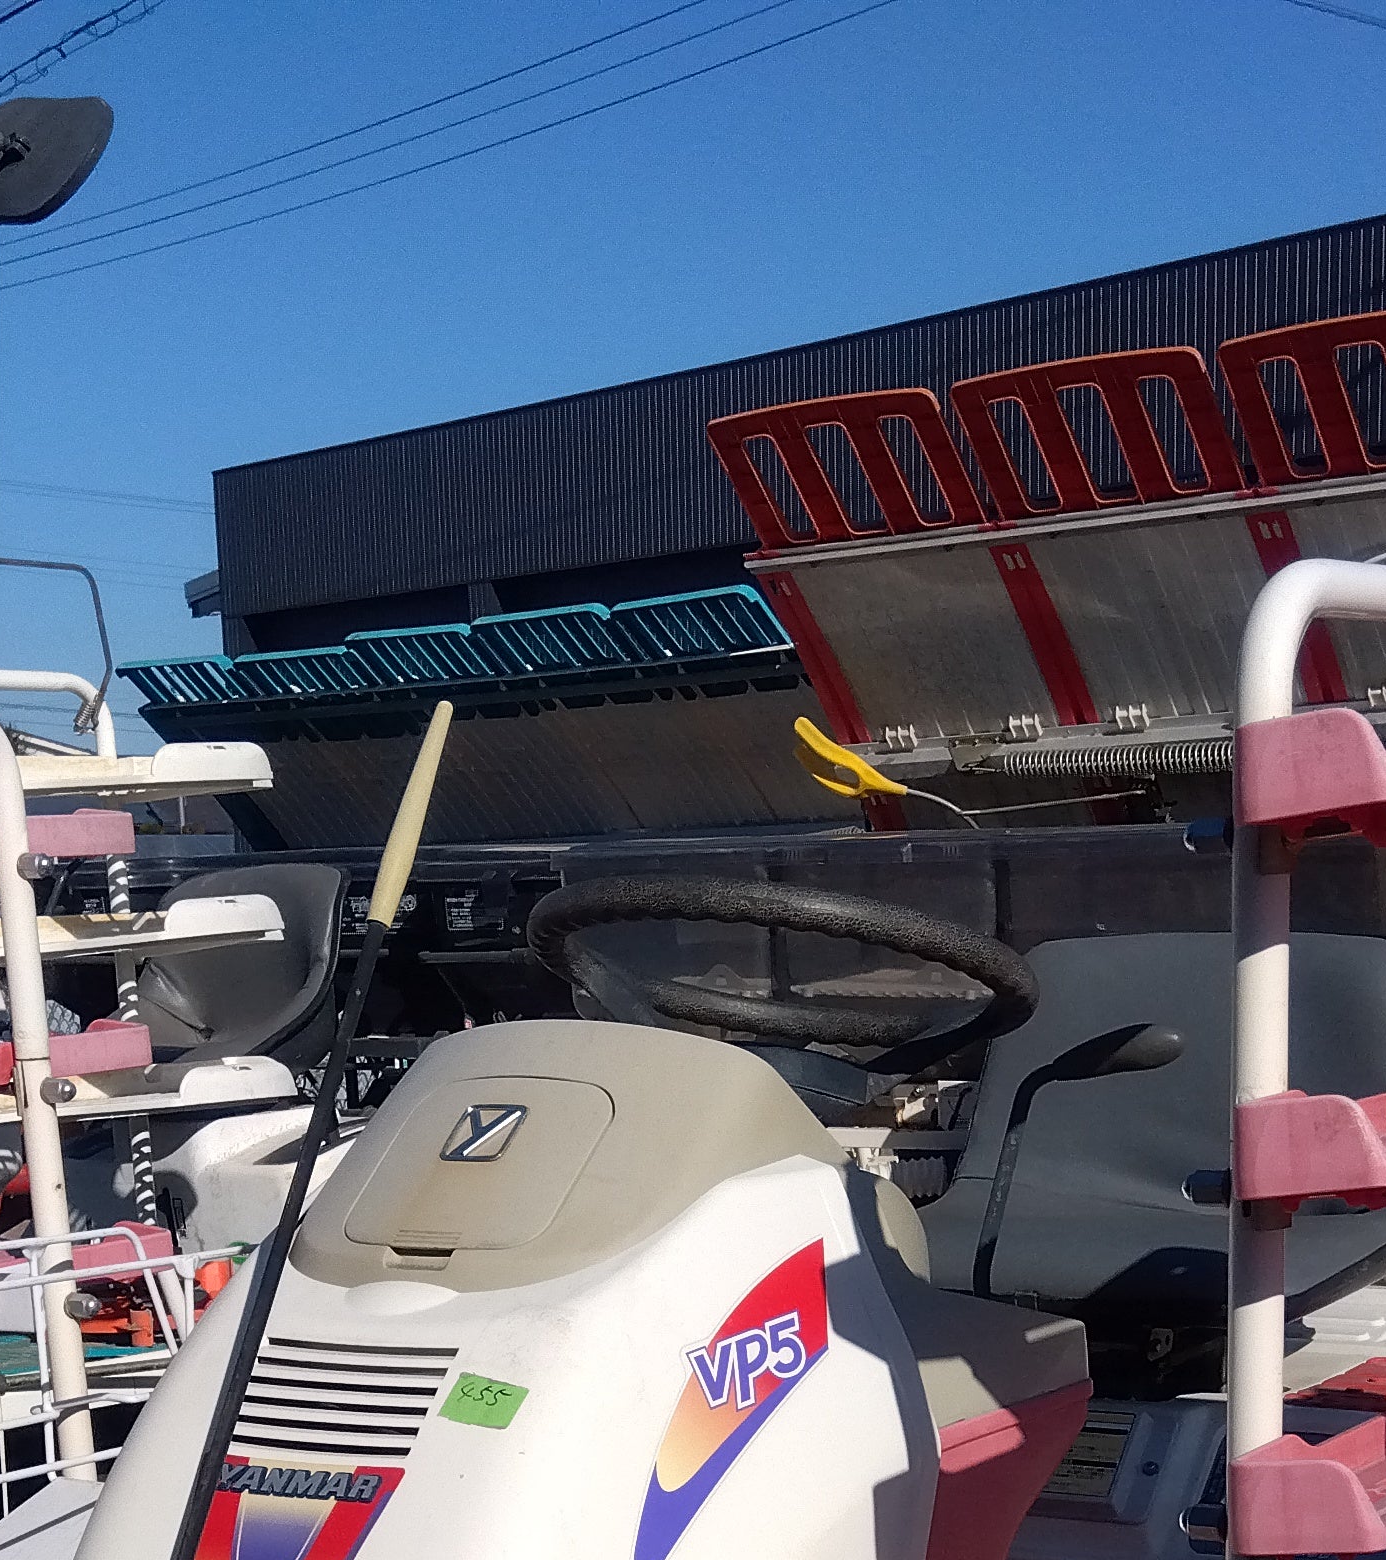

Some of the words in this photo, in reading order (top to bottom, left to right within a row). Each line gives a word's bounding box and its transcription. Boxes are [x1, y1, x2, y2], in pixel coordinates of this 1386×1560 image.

[686, 1309, 806, 1412] VP5
[456, 1381, 513, 1407] 455
[217, 1463, 381, 1502] YANMAR
